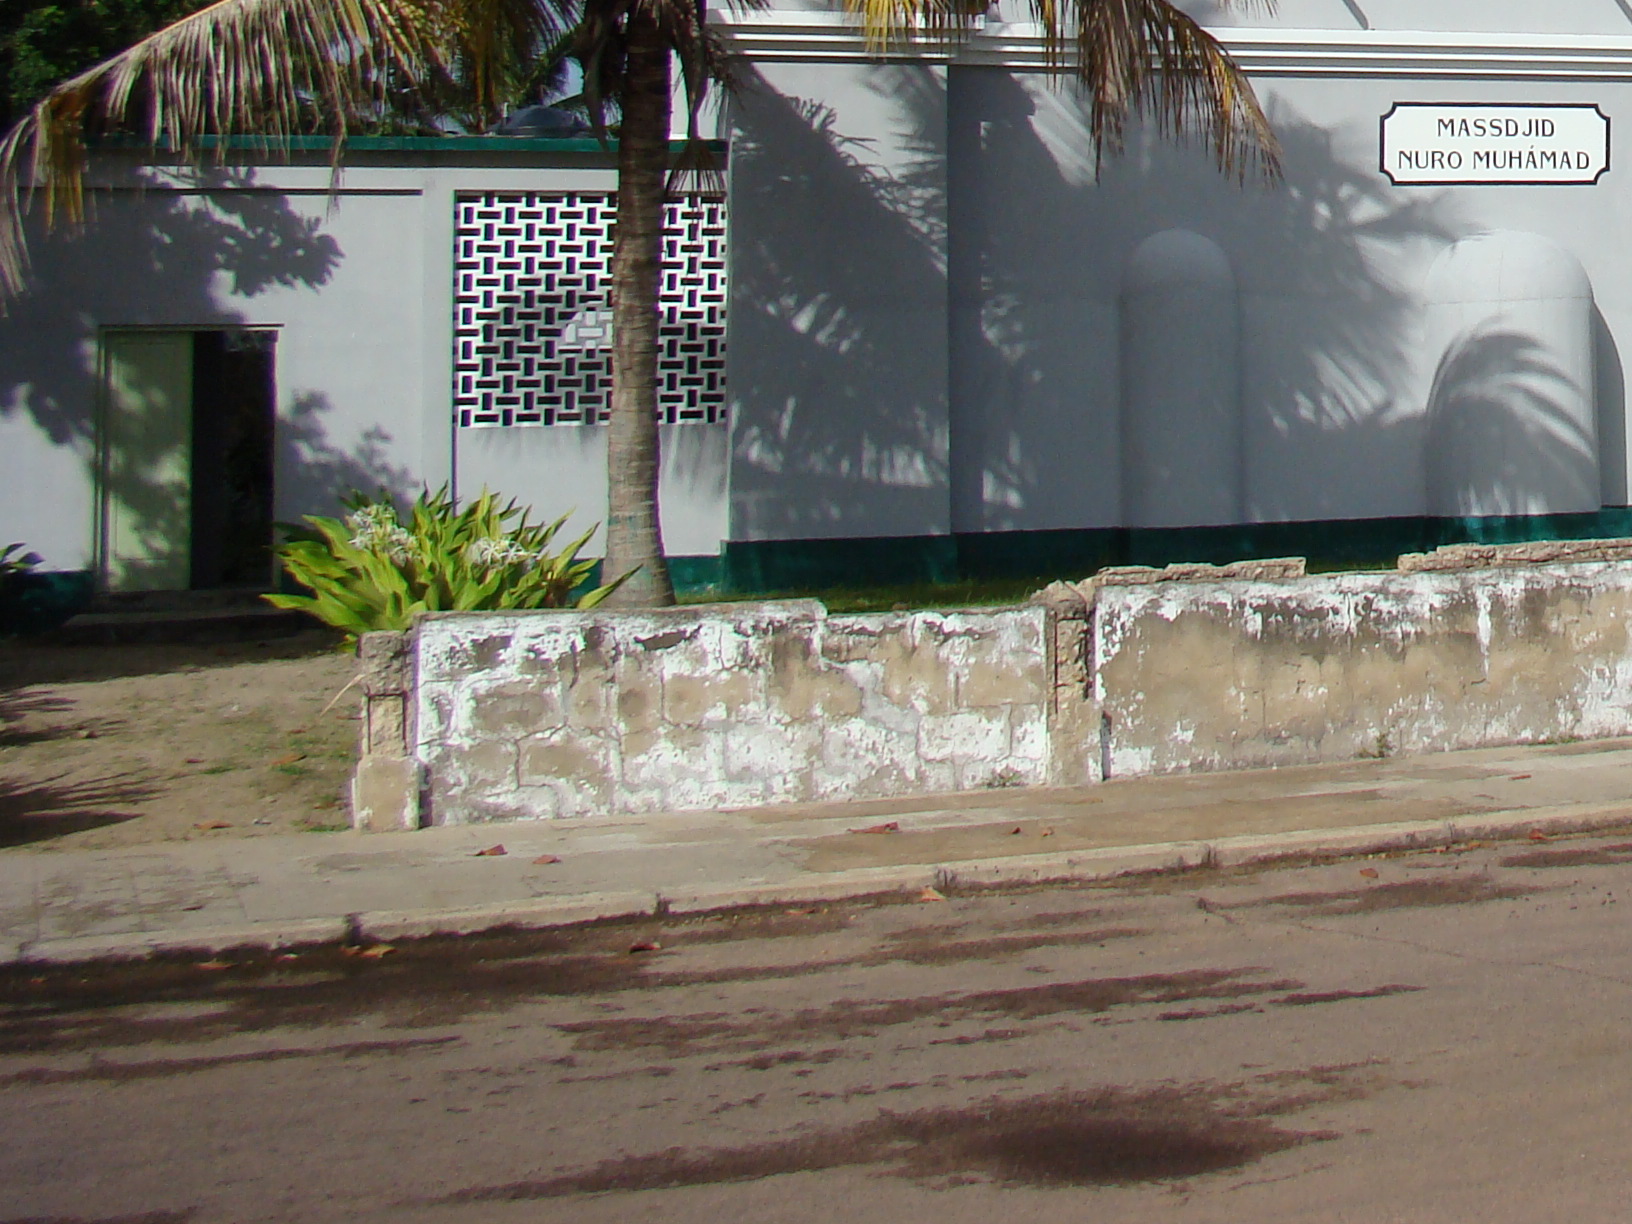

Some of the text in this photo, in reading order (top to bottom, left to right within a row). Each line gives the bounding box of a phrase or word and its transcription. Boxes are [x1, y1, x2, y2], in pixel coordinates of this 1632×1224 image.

[1437, 118, 1555, 137] MASSDJID
[1398, 145, 1590, 170] NURO MUHÁMAD
